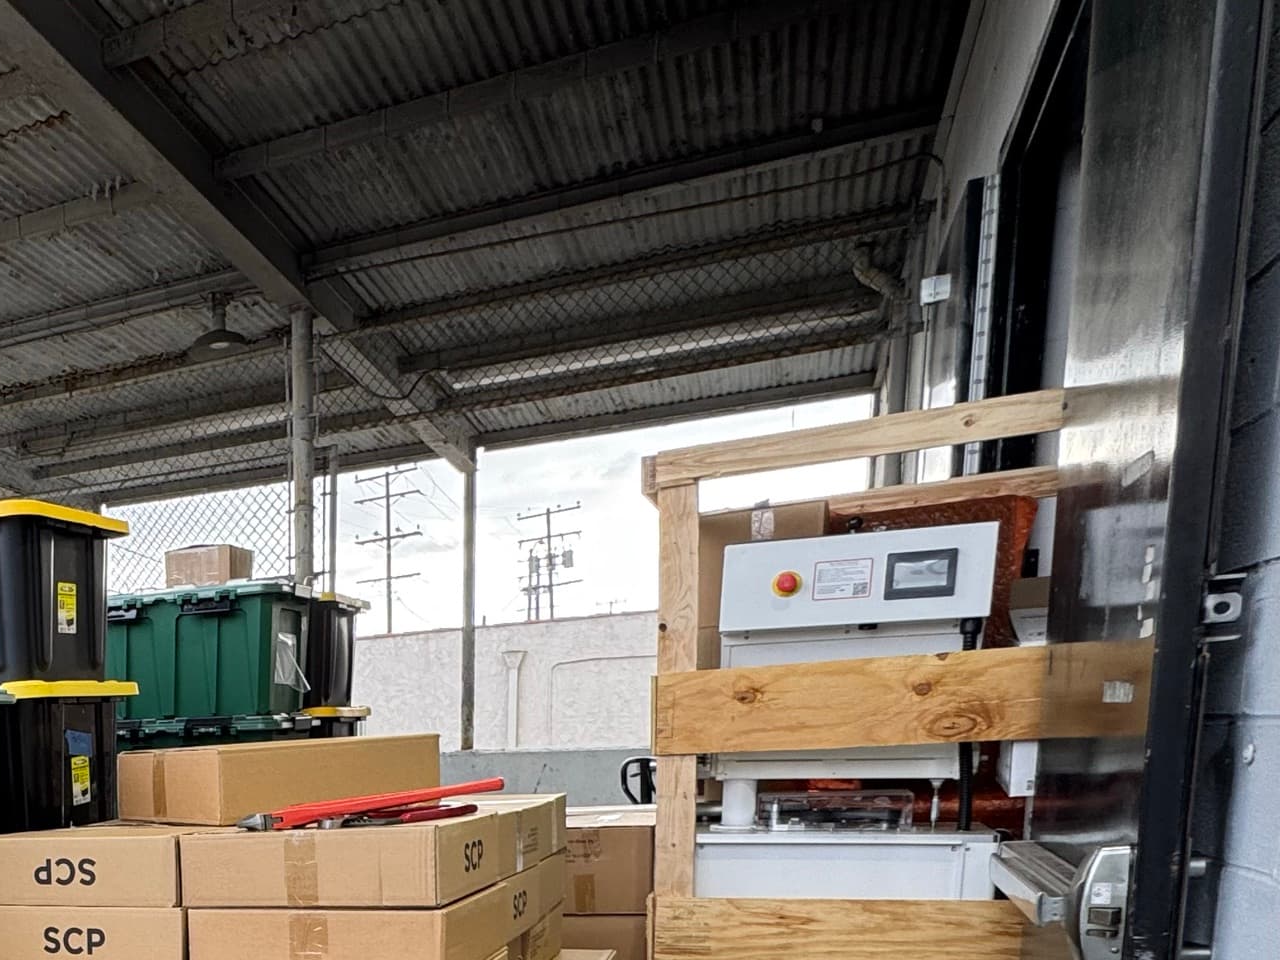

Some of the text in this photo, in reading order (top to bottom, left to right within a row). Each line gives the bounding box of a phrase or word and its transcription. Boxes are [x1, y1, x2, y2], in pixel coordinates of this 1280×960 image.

[464, 839, 484, 873] SCP
[34, 857, 97, 886] SCP
[513, 890, 528, 920] SCP
[43, 926, 106, 956] SCP
